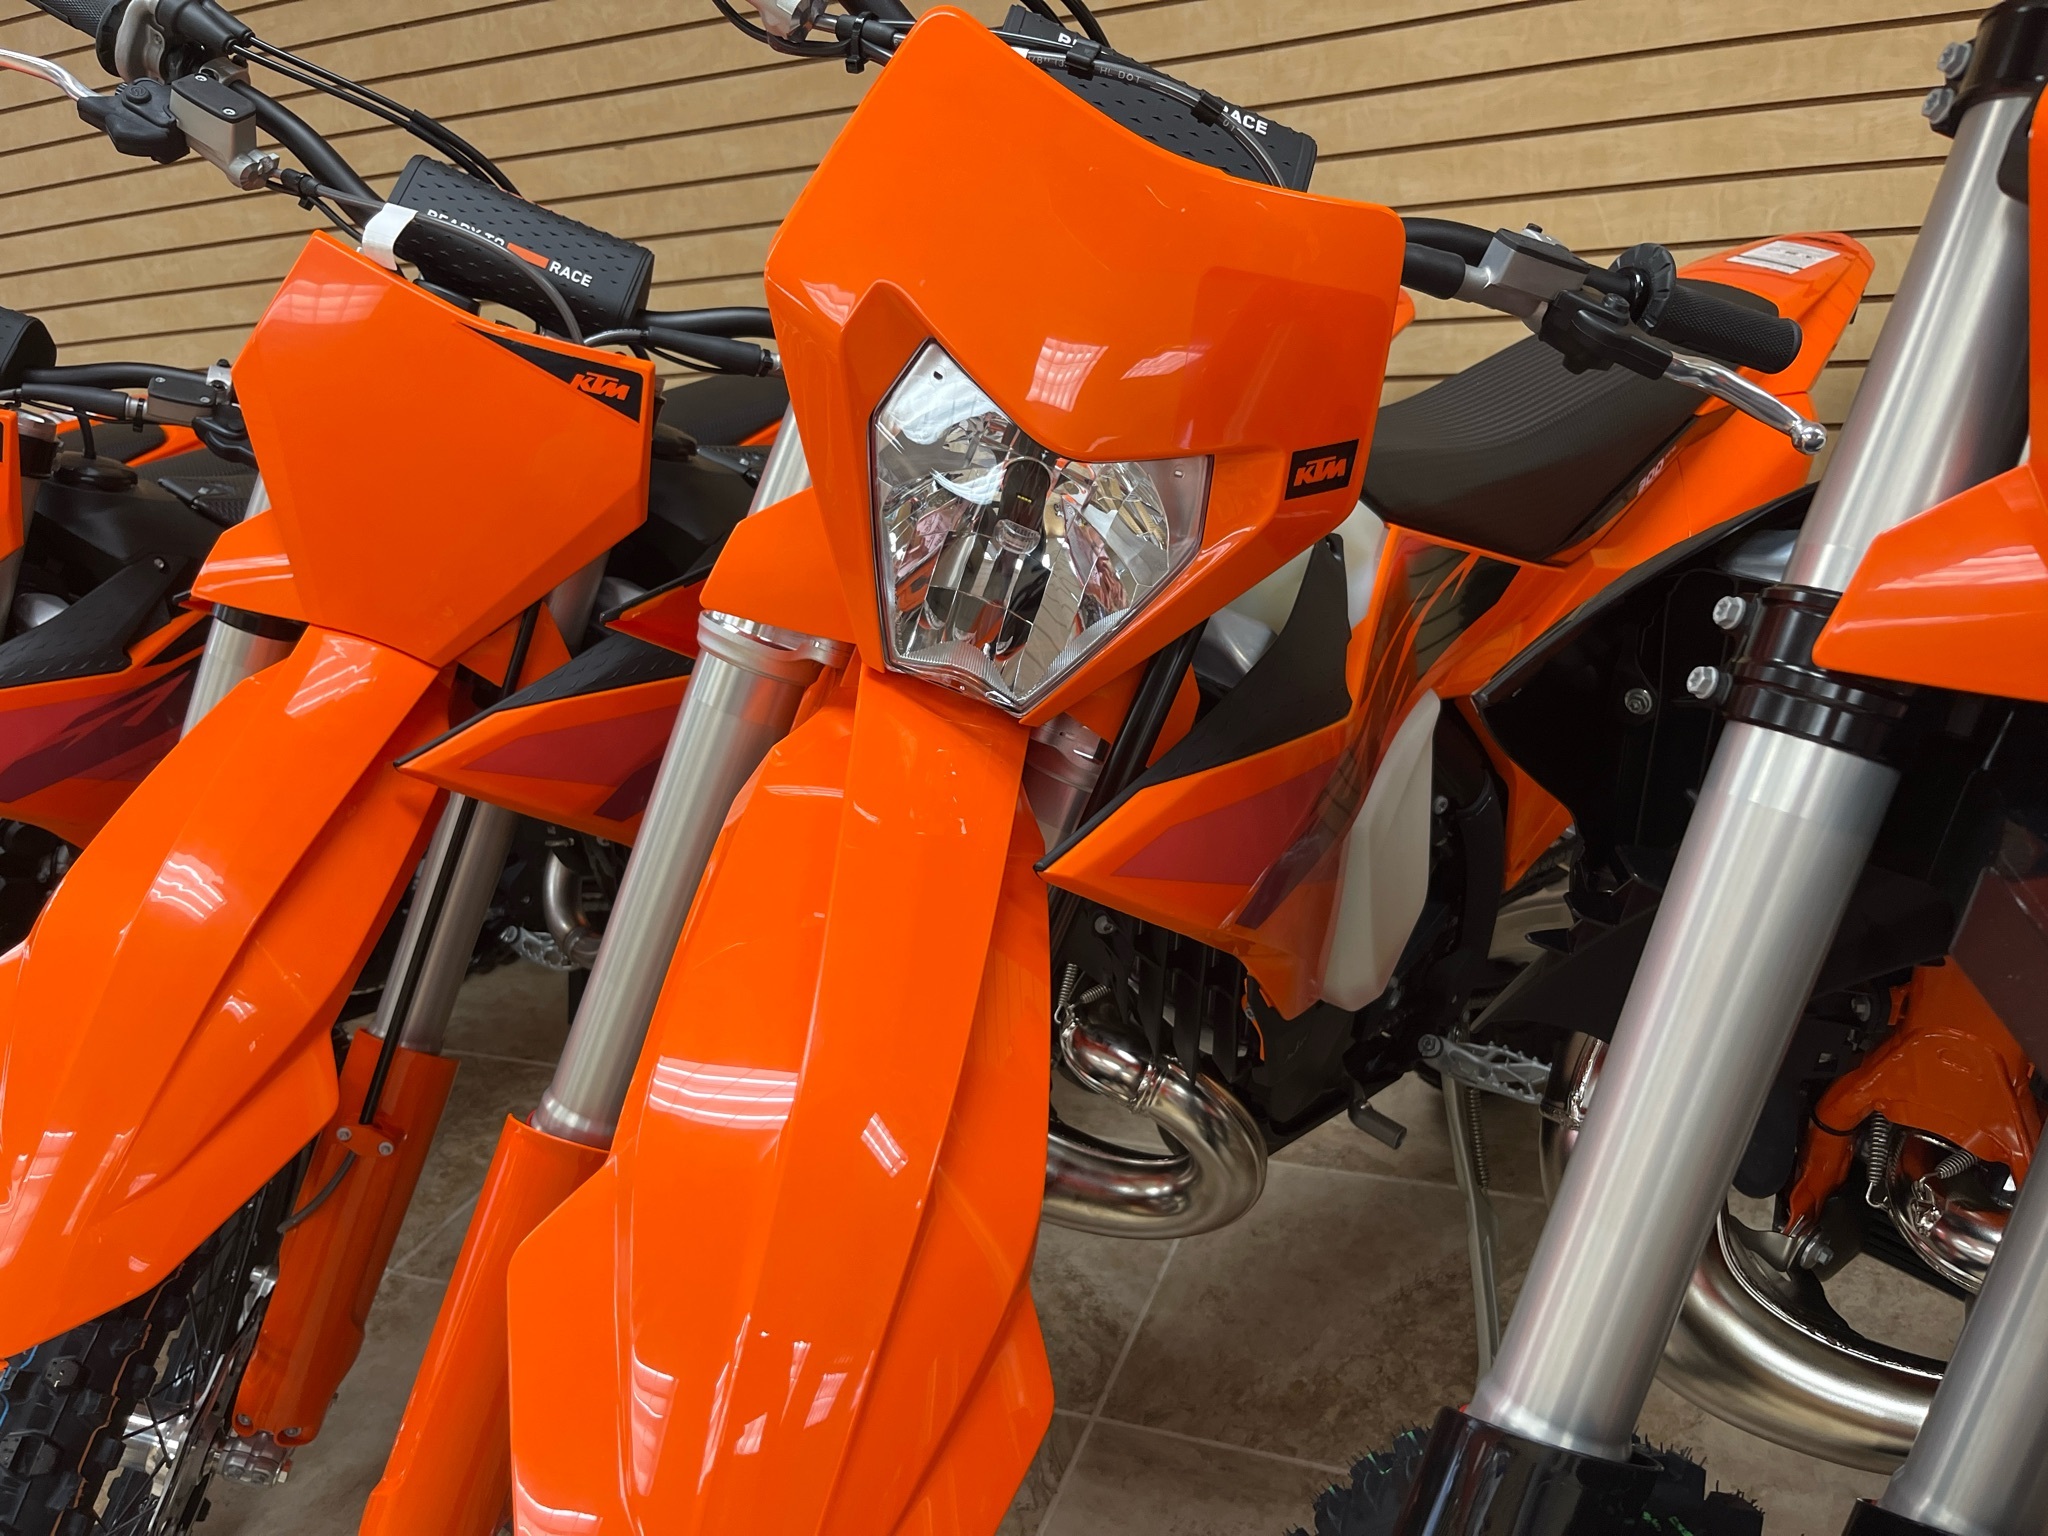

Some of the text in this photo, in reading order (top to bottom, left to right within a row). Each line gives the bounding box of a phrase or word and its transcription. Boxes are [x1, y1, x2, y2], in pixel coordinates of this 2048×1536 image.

[1117, 70, 1141, 84] DOT
[1222, 105, 1269, 136] ACE
[549, 261, 593, 288] RACE
[569, 371, 631, 401] KTM
[1293, 455, 1347, 487] KTM
